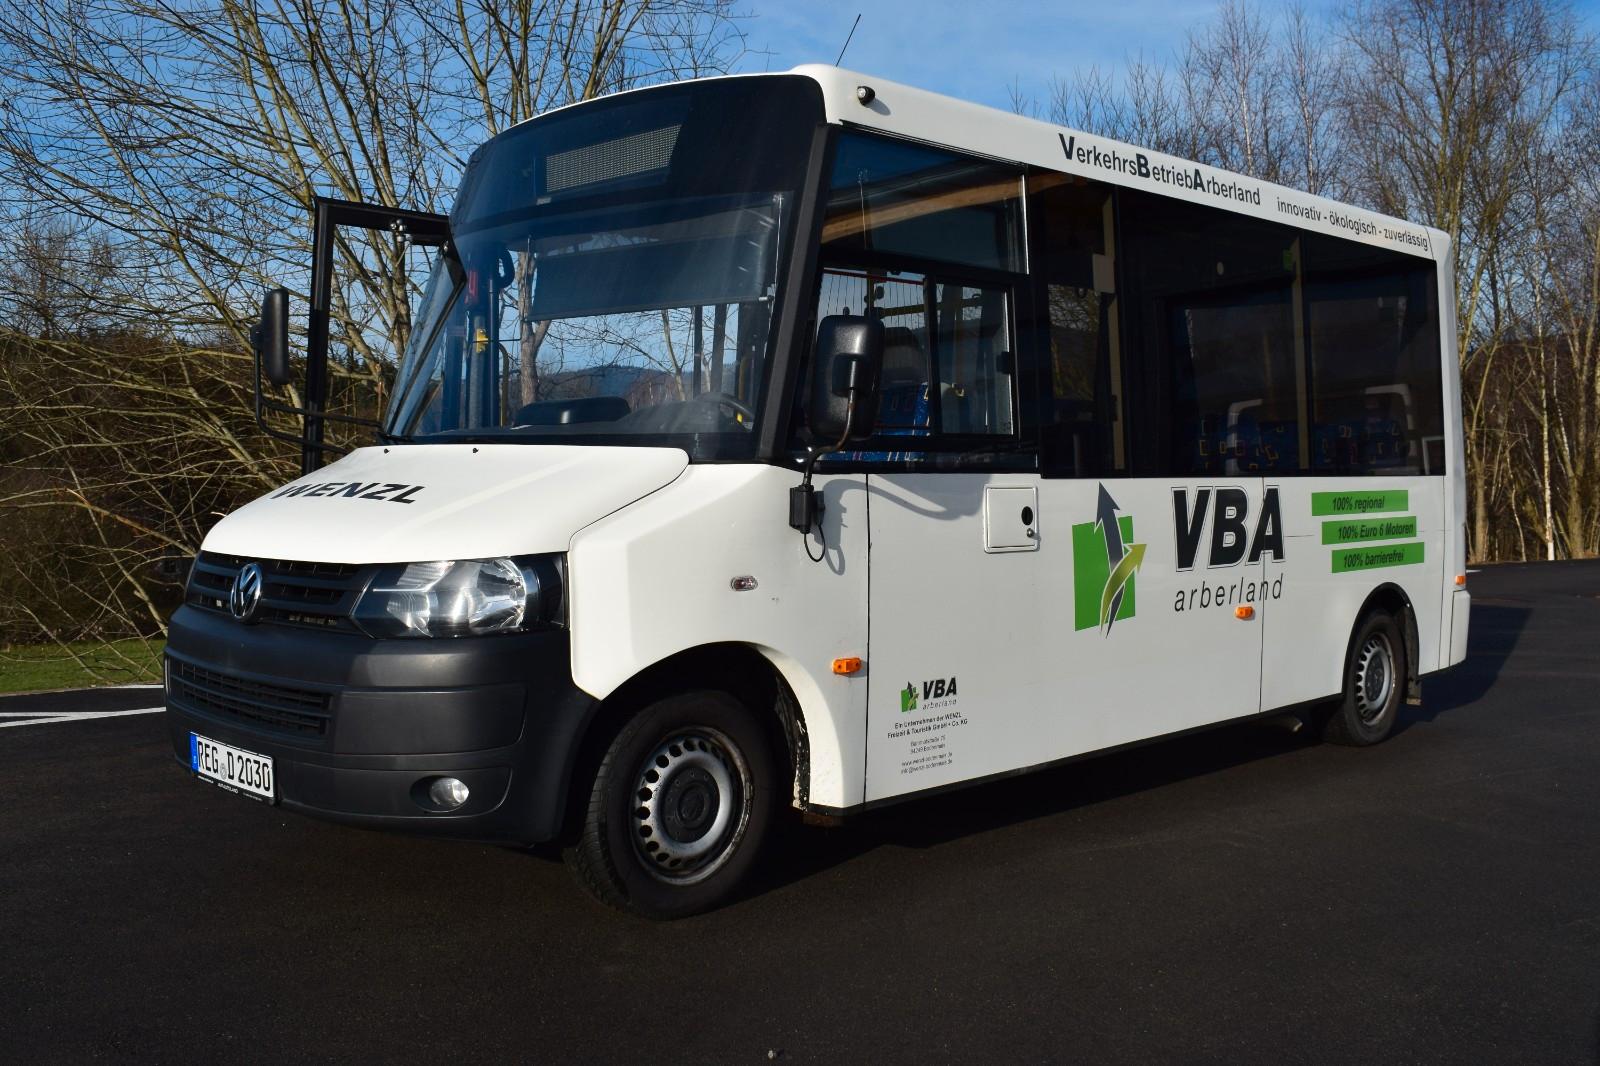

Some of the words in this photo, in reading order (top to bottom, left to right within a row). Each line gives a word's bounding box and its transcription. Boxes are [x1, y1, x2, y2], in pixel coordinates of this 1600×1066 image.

[1276, 196, 1321, 222] innovativ
[1329, 210, 1377, 236] ökologisch
[1384, 227, 1428, 251] zuverlässig
[270, 482, 425, 504] WENZL
[1332, 496, 1353, 512] 100%
[1354, 495, 1385, 512] regional
[1171, 484, 1286, 572] VBA
[1338, 526, 1358, 540] 100%
[1360, 524, 1377, 538] Euro
[1380, 523, 1384, 537] 6
[1385, 522, 1414, 536] Motoren
[1343, 553, 1363, 569] 100%
[1364, 548, 1405, 566] barrierefrei
[1174, 573, 1284, 612] arberland
[923, 676, 957, 700] VBA
[197, 740, 218, 774] REG
[226, 751, 235, 780] D
[237, 755, 271, 792] 2030
